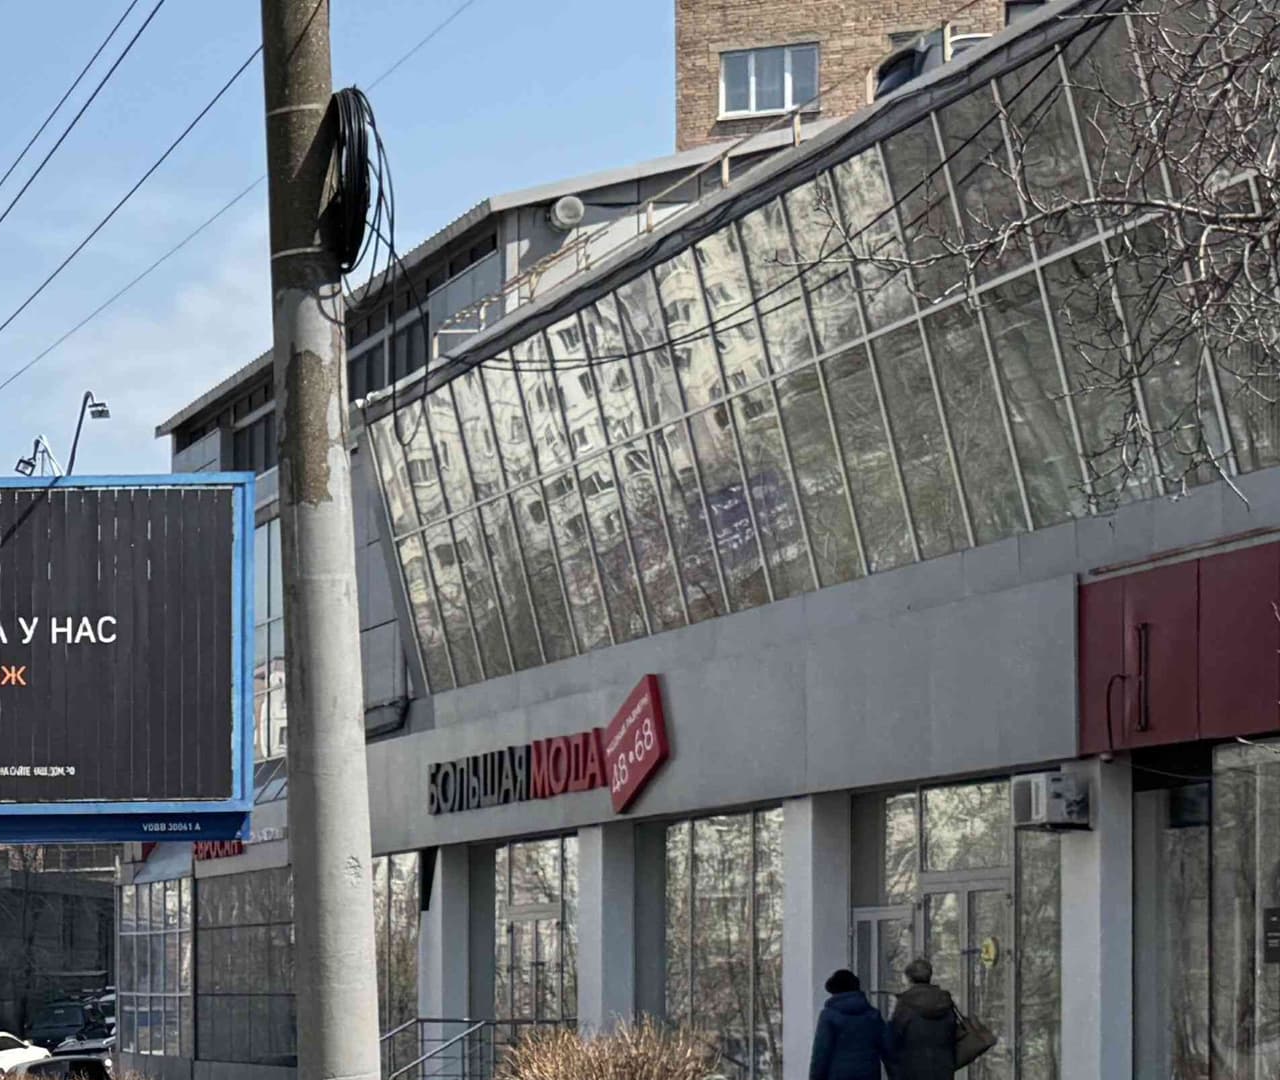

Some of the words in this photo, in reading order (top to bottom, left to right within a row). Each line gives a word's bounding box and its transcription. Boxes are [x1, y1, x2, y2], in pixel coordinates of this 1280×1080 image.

[18, 617, 39, 646] У
[51, 615, 118, 645] НАС
[428, 743, 532, 816] БОЛЬШАЯ
[529, 728, 608, 800] МОДА
